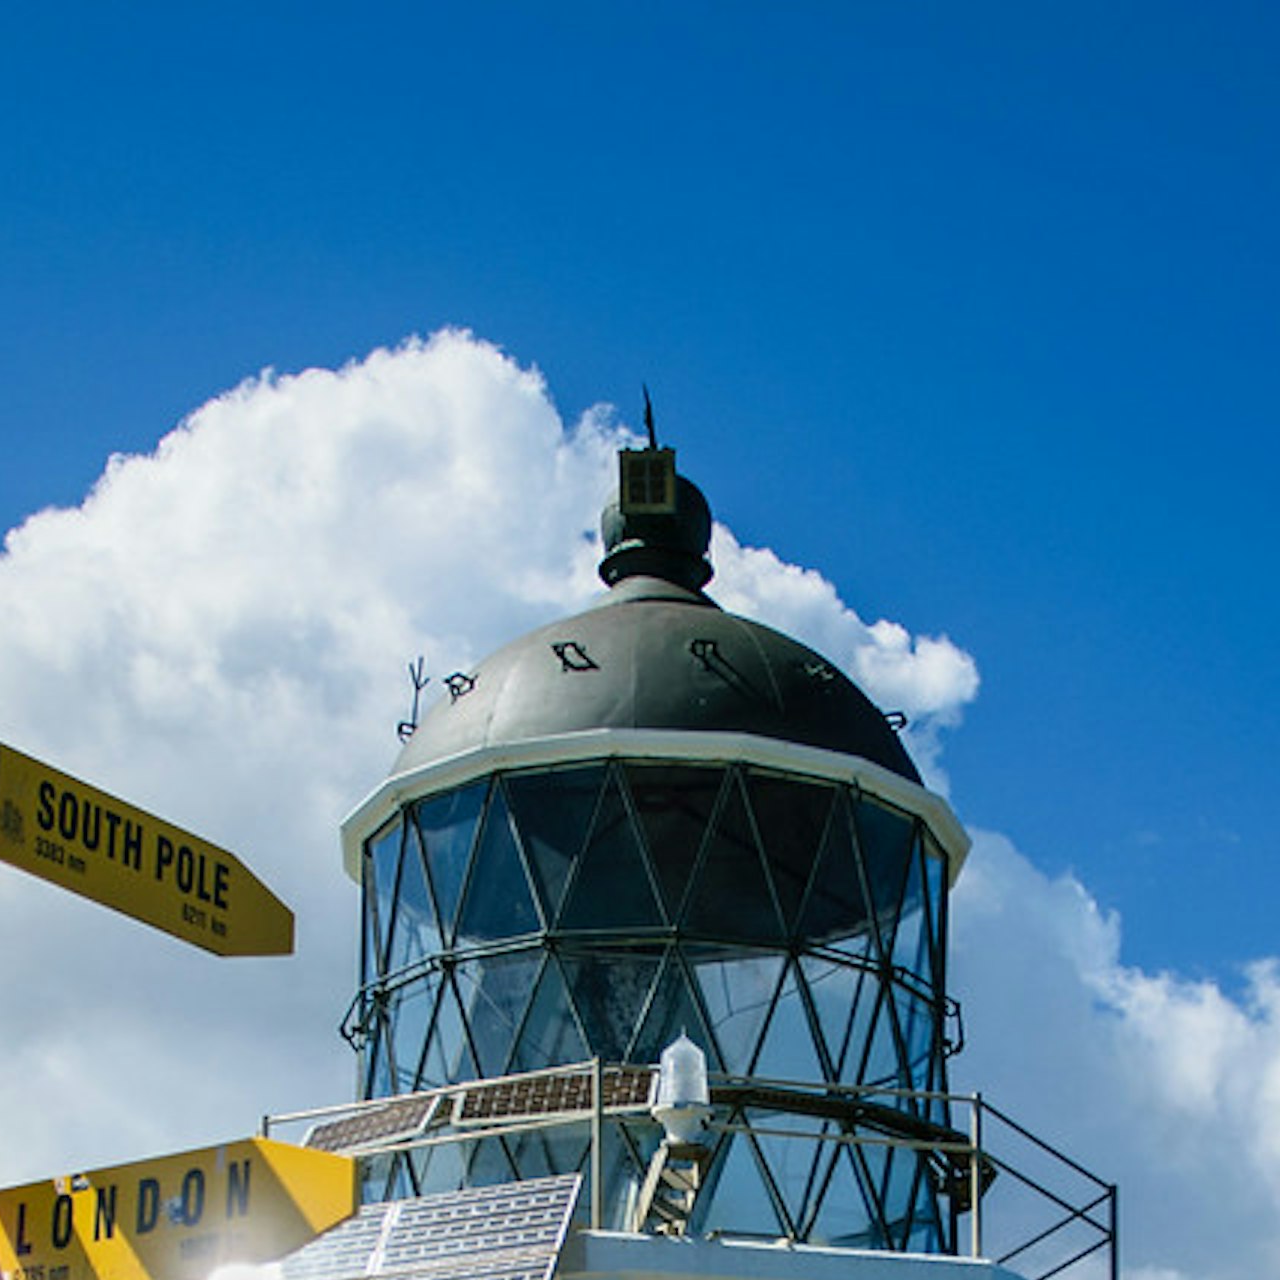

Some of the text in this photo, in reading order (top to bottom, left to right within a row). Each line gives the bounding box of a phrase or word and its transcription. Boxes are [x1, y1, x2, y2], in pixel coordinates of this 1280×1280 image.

[36, 780, 229, 911] SOUTH POLE
[16, 1160, 251, 1257] LONDON
